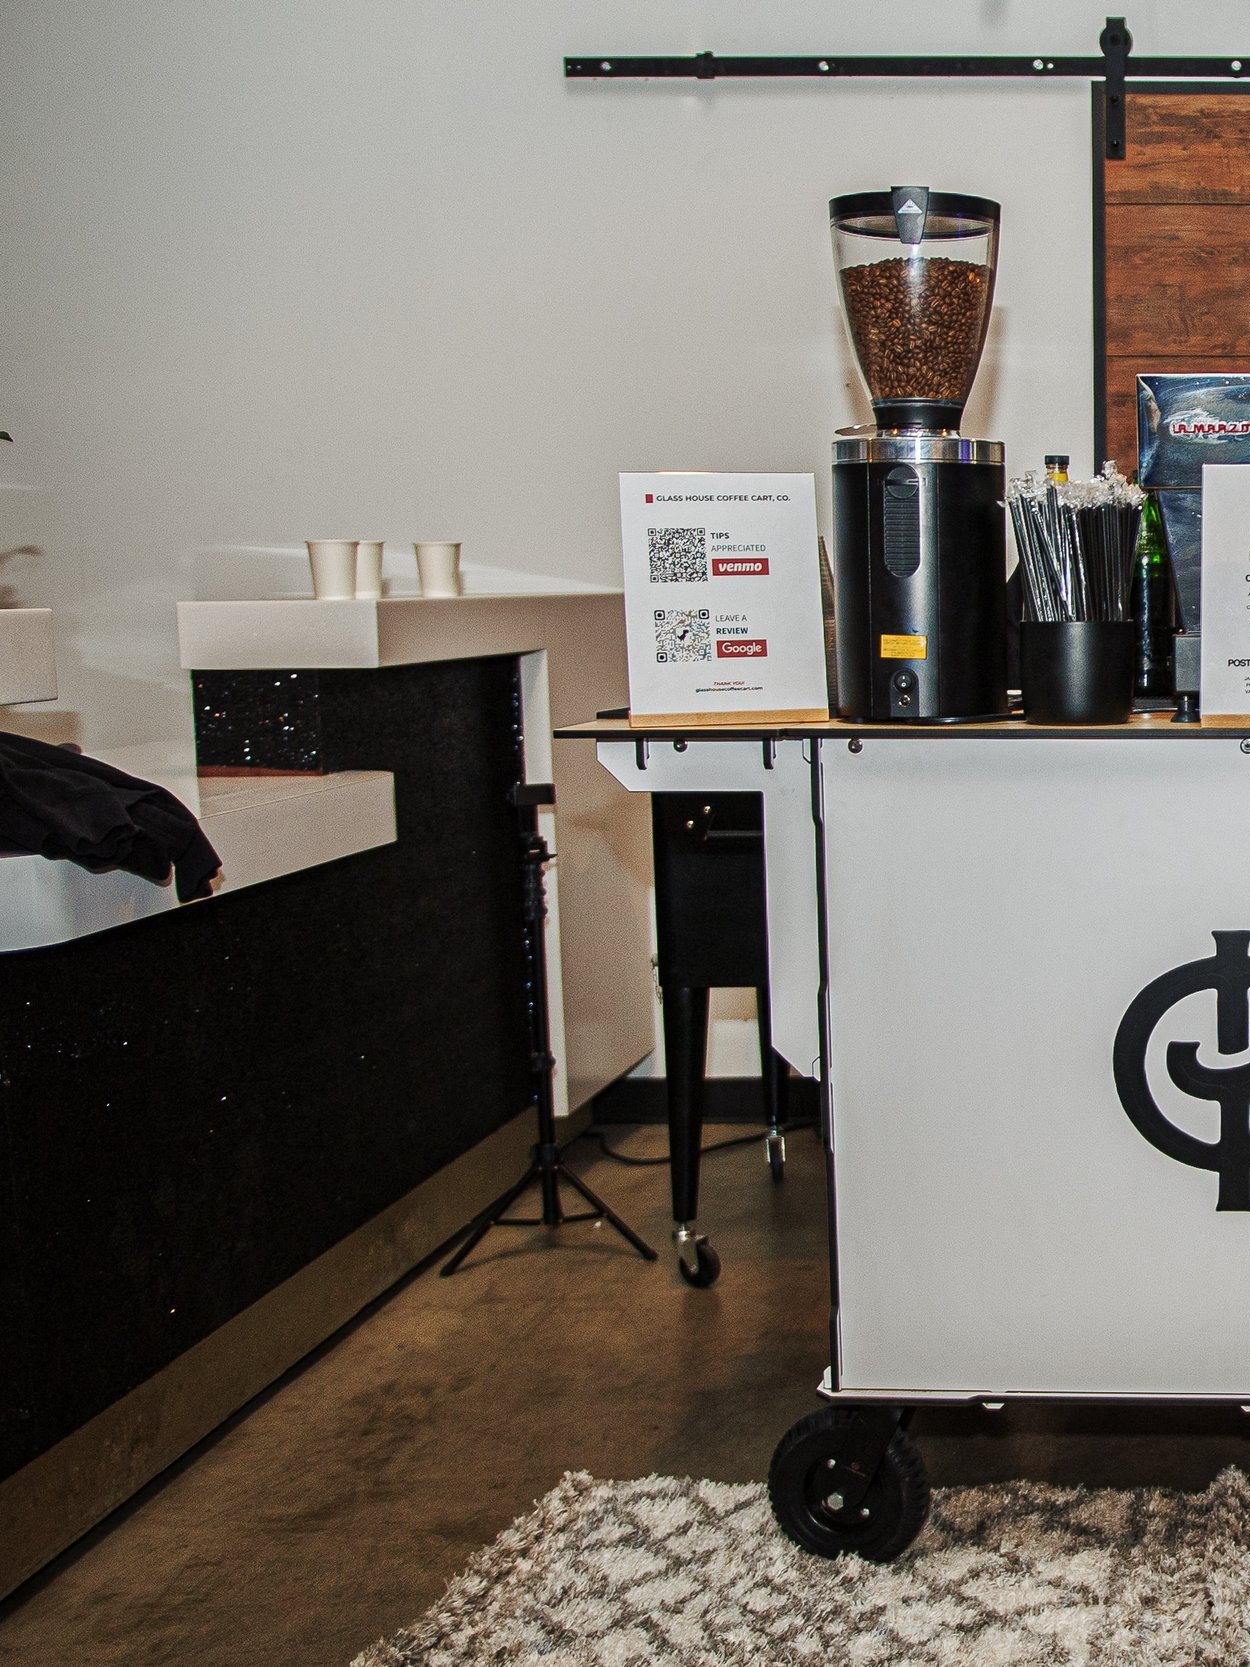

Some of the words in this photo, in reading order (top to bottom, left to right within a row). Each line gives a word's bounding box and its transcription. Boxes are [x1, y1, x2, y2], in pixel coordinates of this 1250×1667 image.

[656, 494, 683, 502] GLASS
[685, 494, 715, 502] HOUSE
[716, 494, 749, 502] COFFEE
[751, 494, 775, 503] CART,
[776, 494, 791, 502] CO.
[710, 532, 730, 540] TIPS
[711, 544, 766, 552] APPRECIATED
[718, 562, 763, 572] venmo
[715, 614, 740, 622] LEAVE
[741, 614, 748, 622] A
[716, 627, 749, 635] REVIEW
[721, 642, 762, 656] Google
